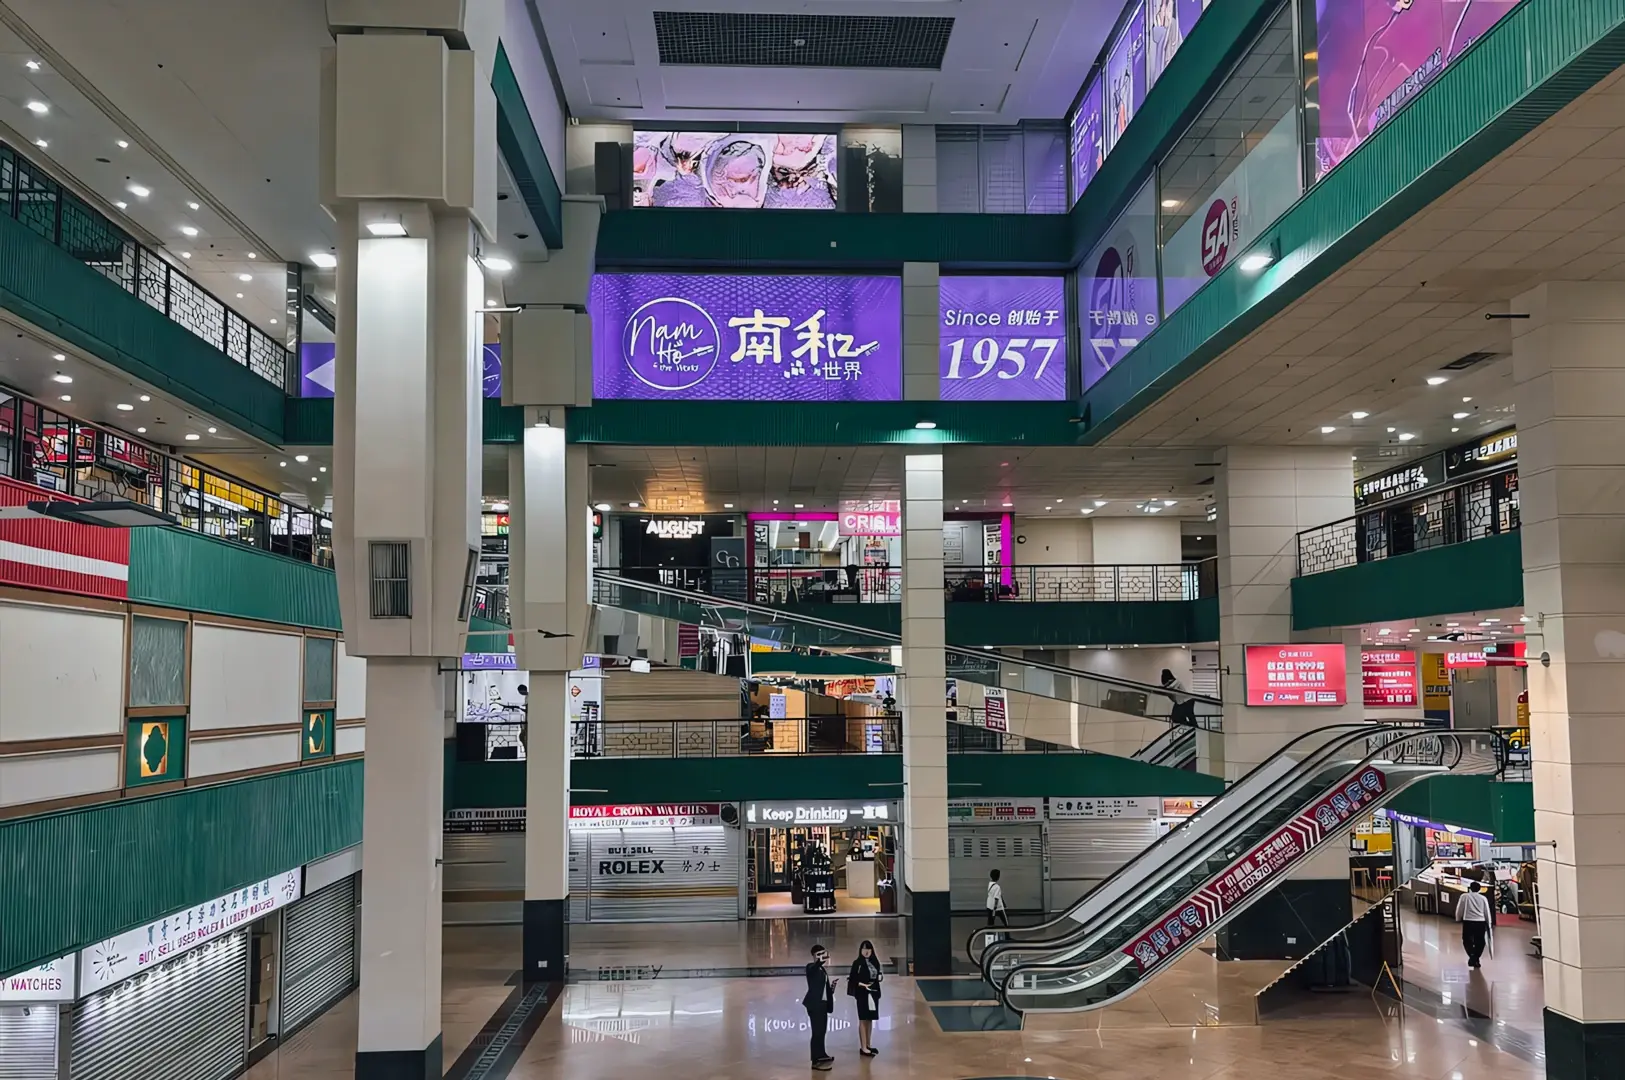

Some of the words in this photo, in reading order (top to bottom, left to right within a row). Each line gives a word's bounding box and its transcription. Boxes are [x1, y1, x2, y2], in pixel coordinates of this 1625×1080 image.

[945, 309, 1001, 326] Since
[1007, 309, 1060, 326] 创始于
[728, 308, 879, 365] 南和
[942, 337, 1060, 380] 1957
[822, 361, 862, 381] 世界
[645, 519, 706, 535] AUGUST
[572, 807, 610, 817] ROYAL
[612, 806, 653, 816] CROWN
[762, 807, 794, 822] Keep
[795, 806, 848, 821] Drinking
[599, 860, 665, 875] ROLEX
[11, 977, 62, 991] WATCHES
